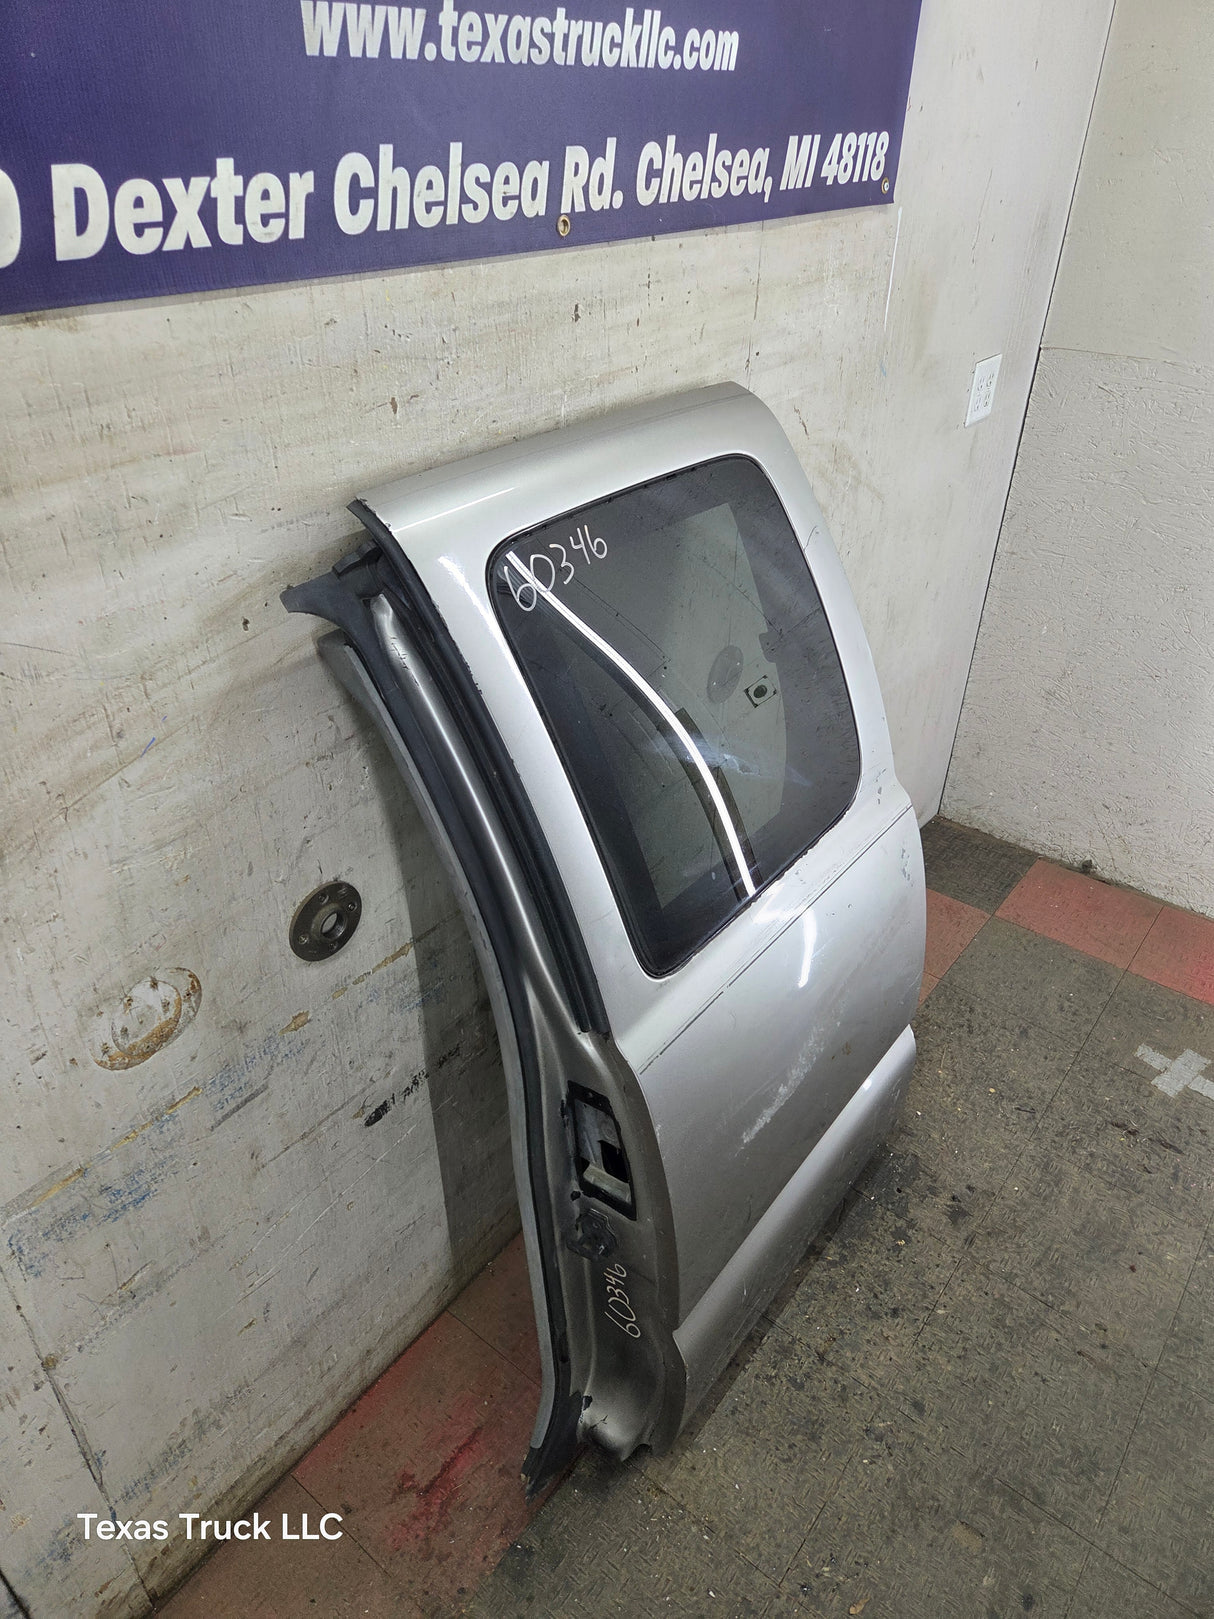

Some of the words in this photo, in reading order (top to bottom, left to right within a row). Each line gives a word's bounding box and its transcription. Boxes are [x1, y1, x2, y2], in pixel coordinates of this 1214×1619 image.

[301, 0, 740, 72] www.texastruckllc.com
[50, 156, 315, 262] Dexter
[333, 141, 551, 236] Chelsea
[560, 136, 624, 214] Rd.
[635, 132, 770, 207] Chelsea,
[779, 133, 821, 191] MI
[820, 130, 890, 186] 48118
[503, 524, 608, 612] 60346
[604, 1262, 642, 1339] 60346
